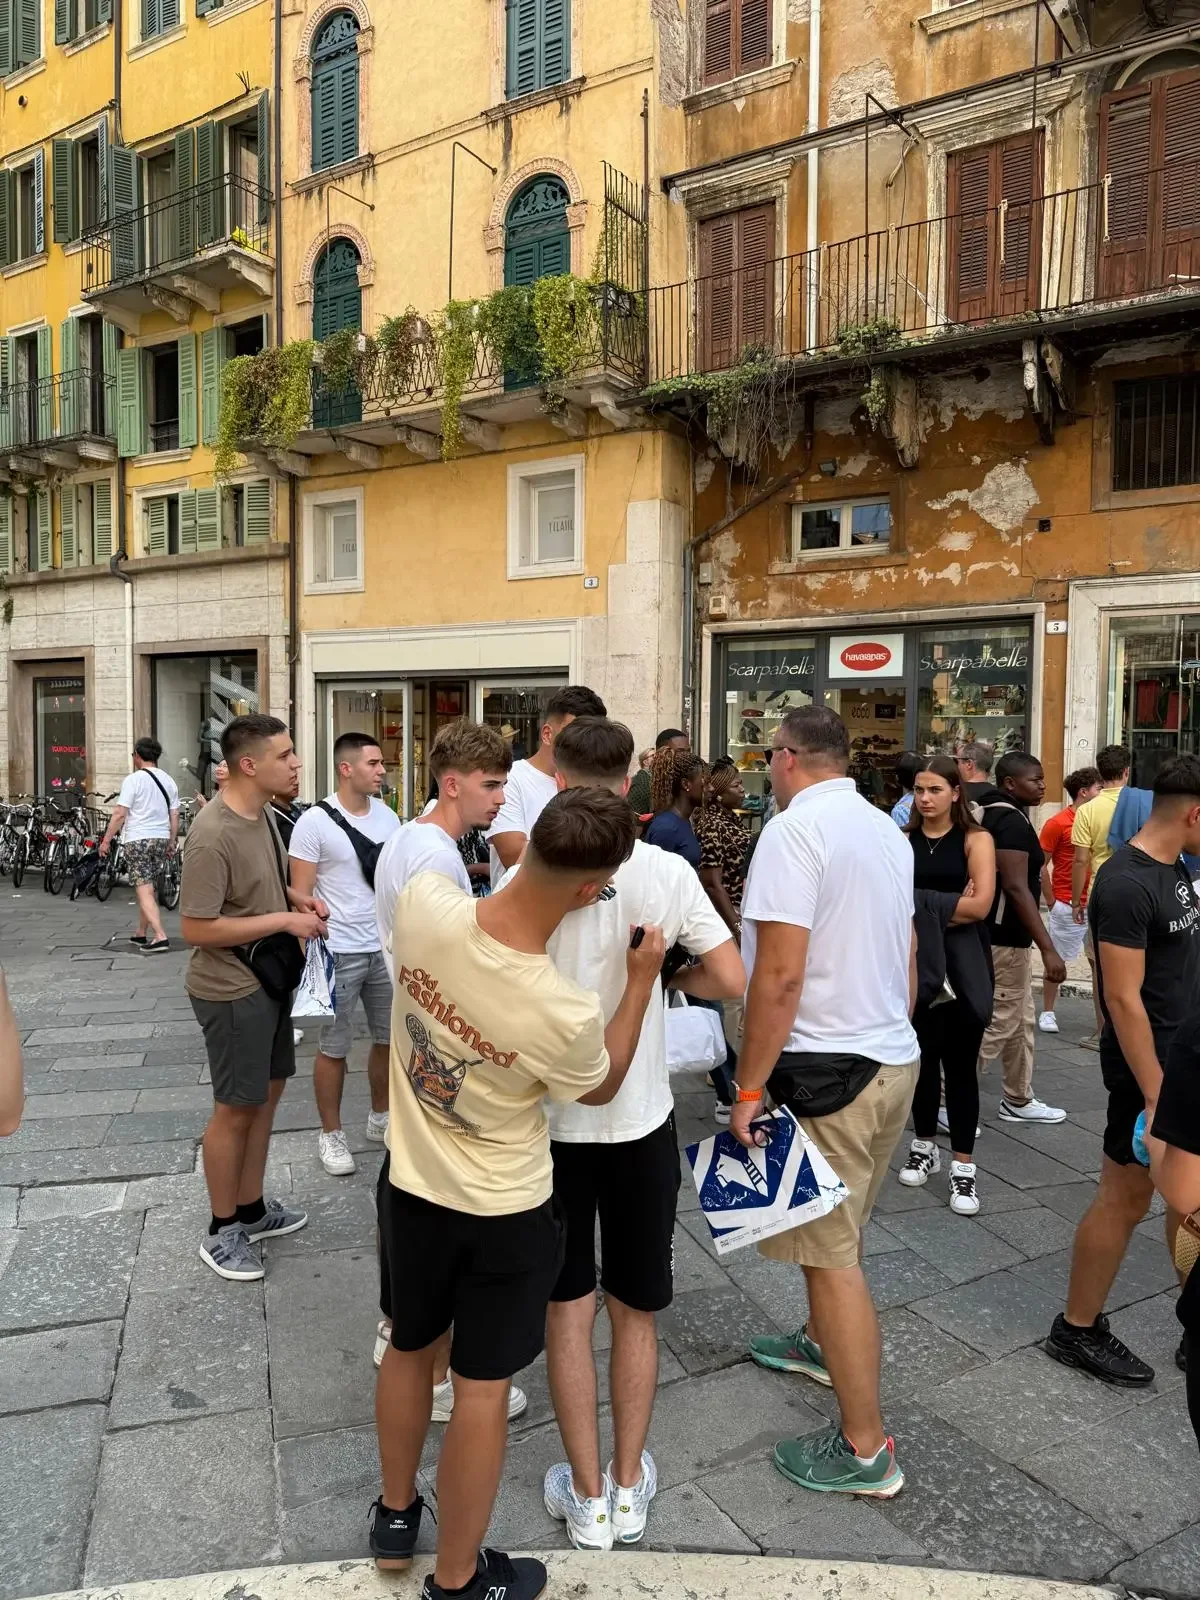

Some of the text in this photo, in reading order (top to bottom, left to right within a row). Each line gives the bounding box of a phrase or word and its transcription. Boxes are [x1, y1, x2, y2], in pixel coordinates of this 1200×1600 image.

[1053, 622, 1060, 631] 5
[728, 655, 815, 684] Scarpabella
[919, 646, 1028, 678] Scarpabella
[412, 968, 439, 992] Old
[398, 964, 519, 1069] Fashioned
